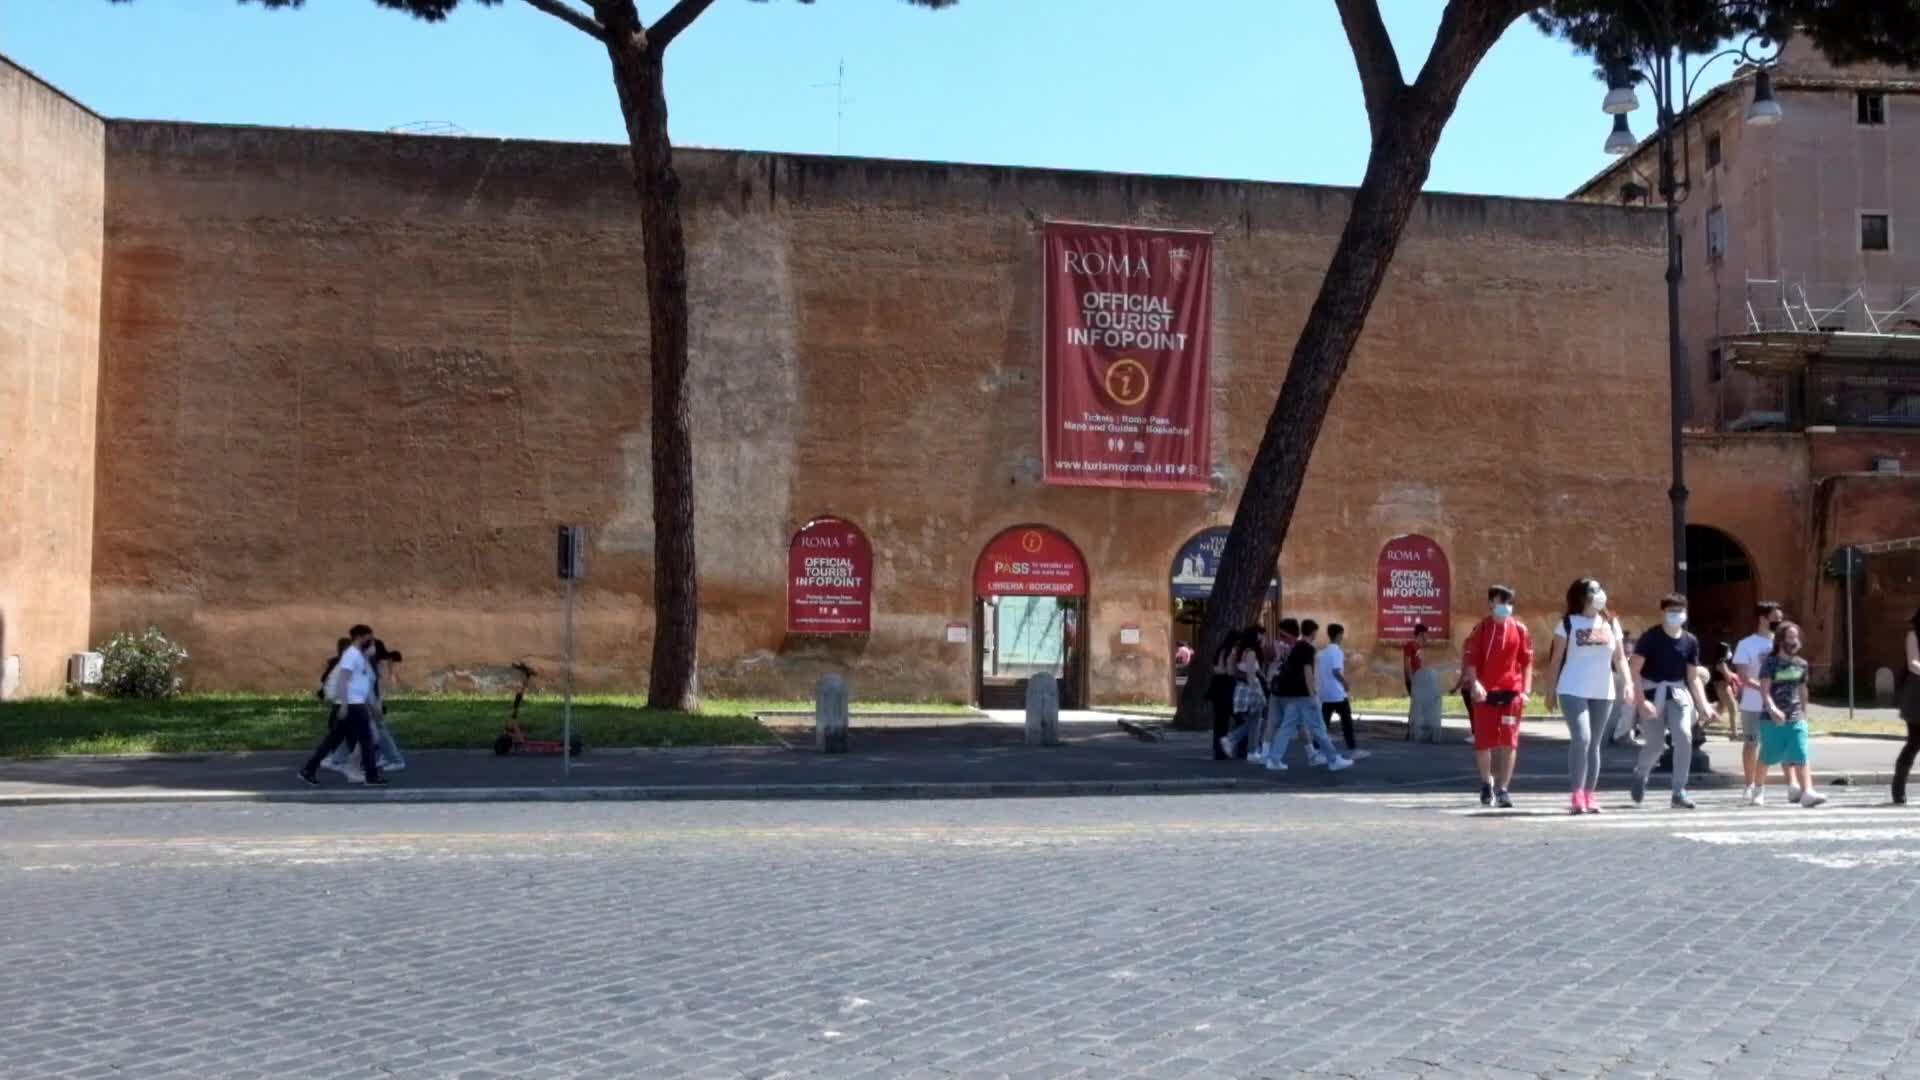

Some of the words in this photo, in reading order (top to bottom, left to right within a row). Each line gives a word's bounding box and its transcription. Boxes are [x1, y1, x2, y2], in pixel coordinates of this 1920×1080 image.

[1063, 250, 1151, 279] ROMA
[1083, 291, 1174, 314] OFFICIAL
[1082, 310, 1174, 332] TOURIST
[1067, 327, 1187, 350] INFOPOINT
[1089, 422, 1105, 432] and
[1107, 423, 1139, 433] Guides
[1055, 460, 1162, 474] www.turismoroma.it
[801, 536, 840, 548] ROMA
[1387, 550, 1420, 560] ROMA
[805, 558, 853, 567] OFFICIAL
[805, 567, 853, 576] TOURIST
[994, 562, 1029, 574] PASS
[1390, 570, 1432, 578] OFFICIAL
[796, 577, 861, 587] INFOPOINT
[1391, 579, 1433, 587] TOURIST
[1029, 583, 1073, 592] BOOKSHOP
[1383, 588, 1440, 597] INFOPOINT
